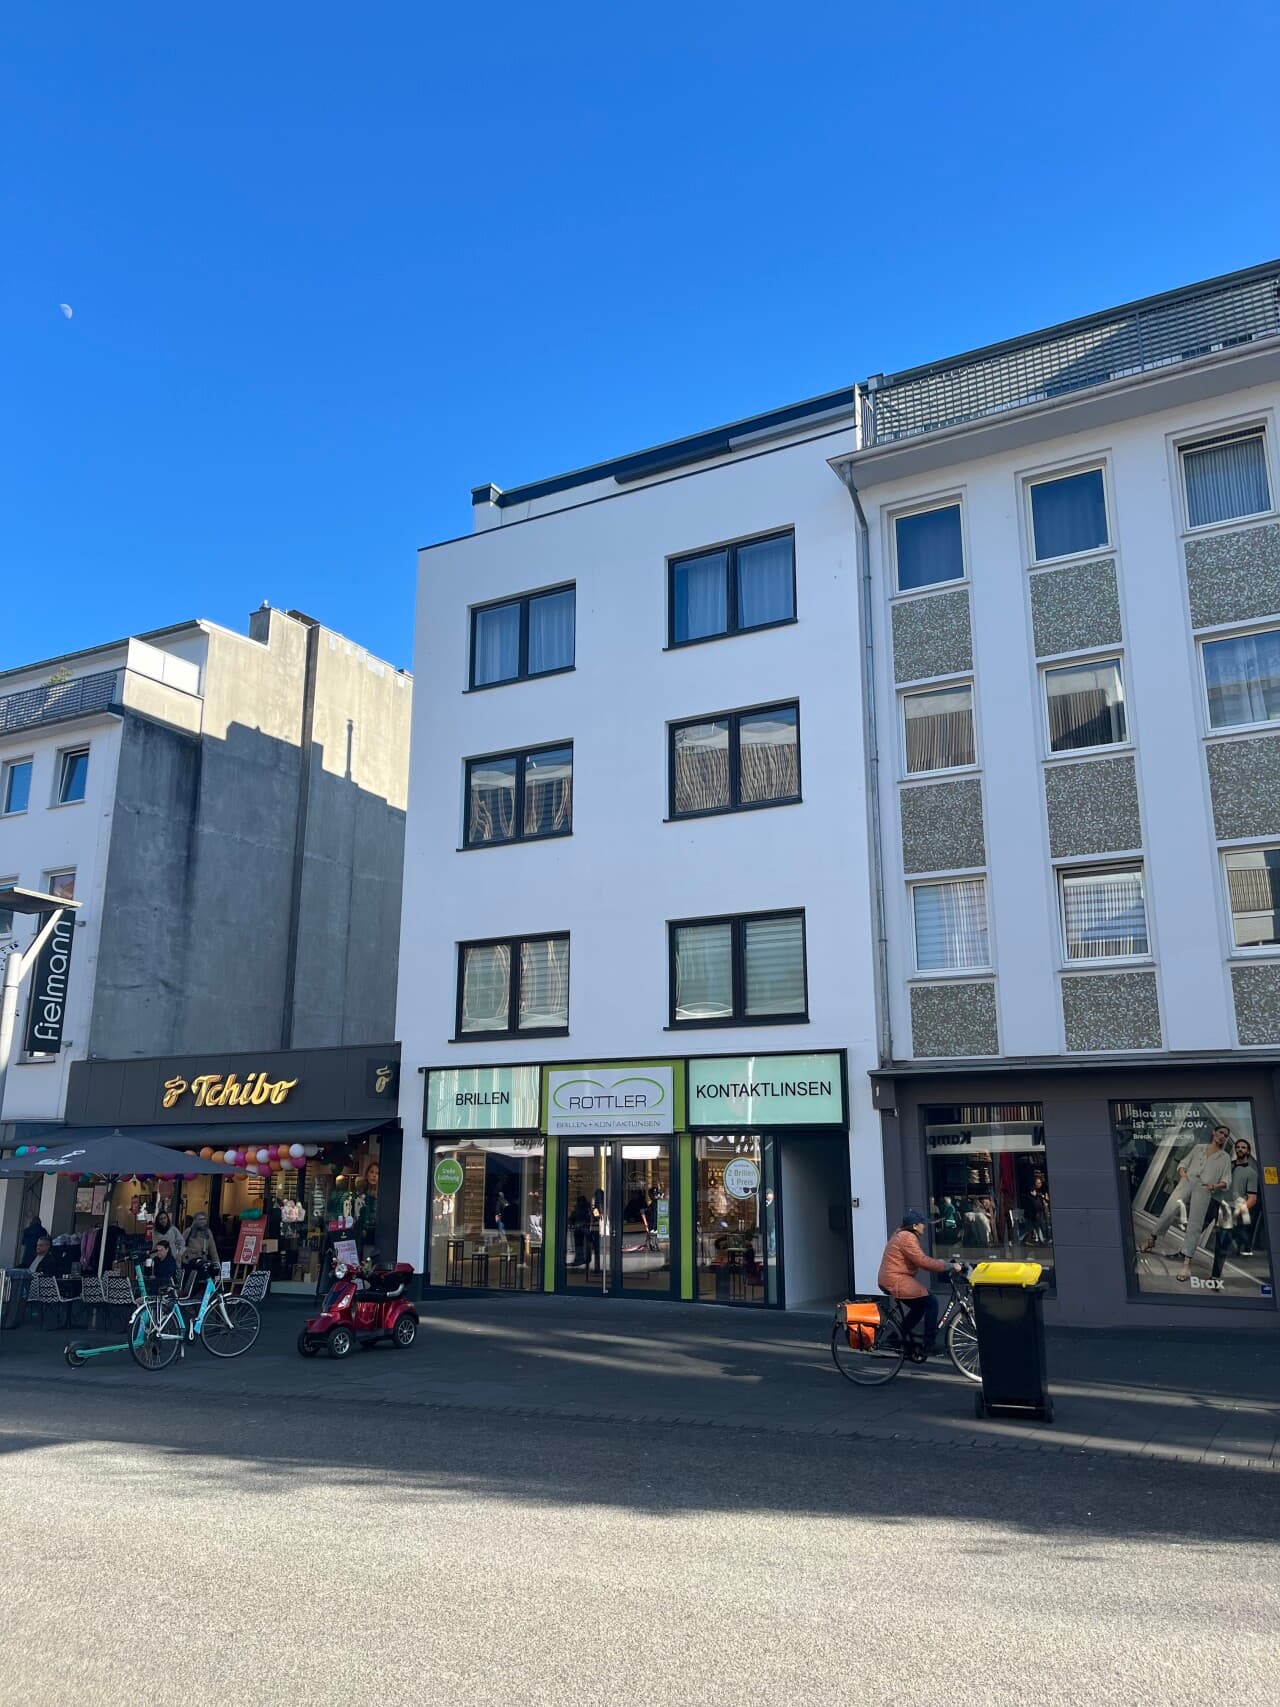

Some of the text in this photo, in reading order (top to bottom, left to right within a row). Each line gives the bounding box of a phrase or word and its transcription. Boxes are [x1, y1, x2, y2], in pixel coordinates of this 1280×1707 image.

[34, 920, 71, 1040] fielmann
[191, 1072, 298, 1107] Tchibo
[696, 1081, 832, 1099] KONTAKTLINSEN
[455, 1091, 510, 1106] BRILLEN
[569, 1095, 647, 1109] ROTTLER
[1159, 1110, 1172, 1118] zu
[1132, 1119, 1146, 1129] ist
[1190, 1276, 1225, 1290] Brax
